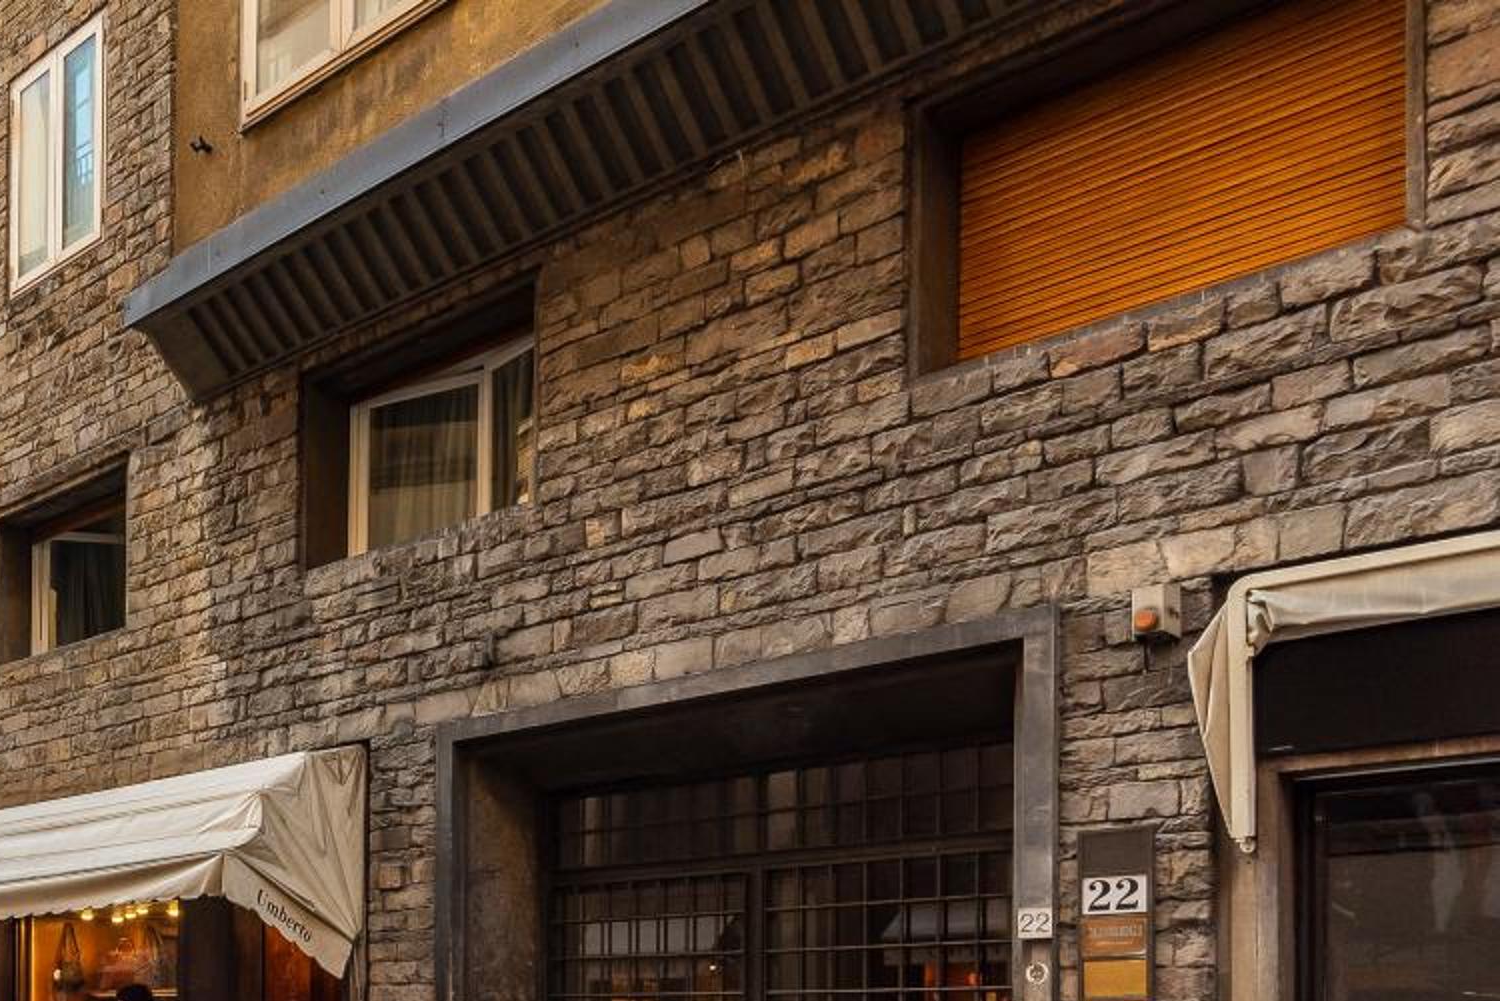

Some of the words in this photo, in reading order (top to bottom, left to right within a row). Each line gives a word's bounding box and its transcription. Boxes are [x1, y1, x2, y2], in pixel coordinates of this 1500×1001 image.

[1088, 877, 1139, 912] 22
[257, 888, 312, 943] Umberto
[1019, 911, 1051, 934] 22
